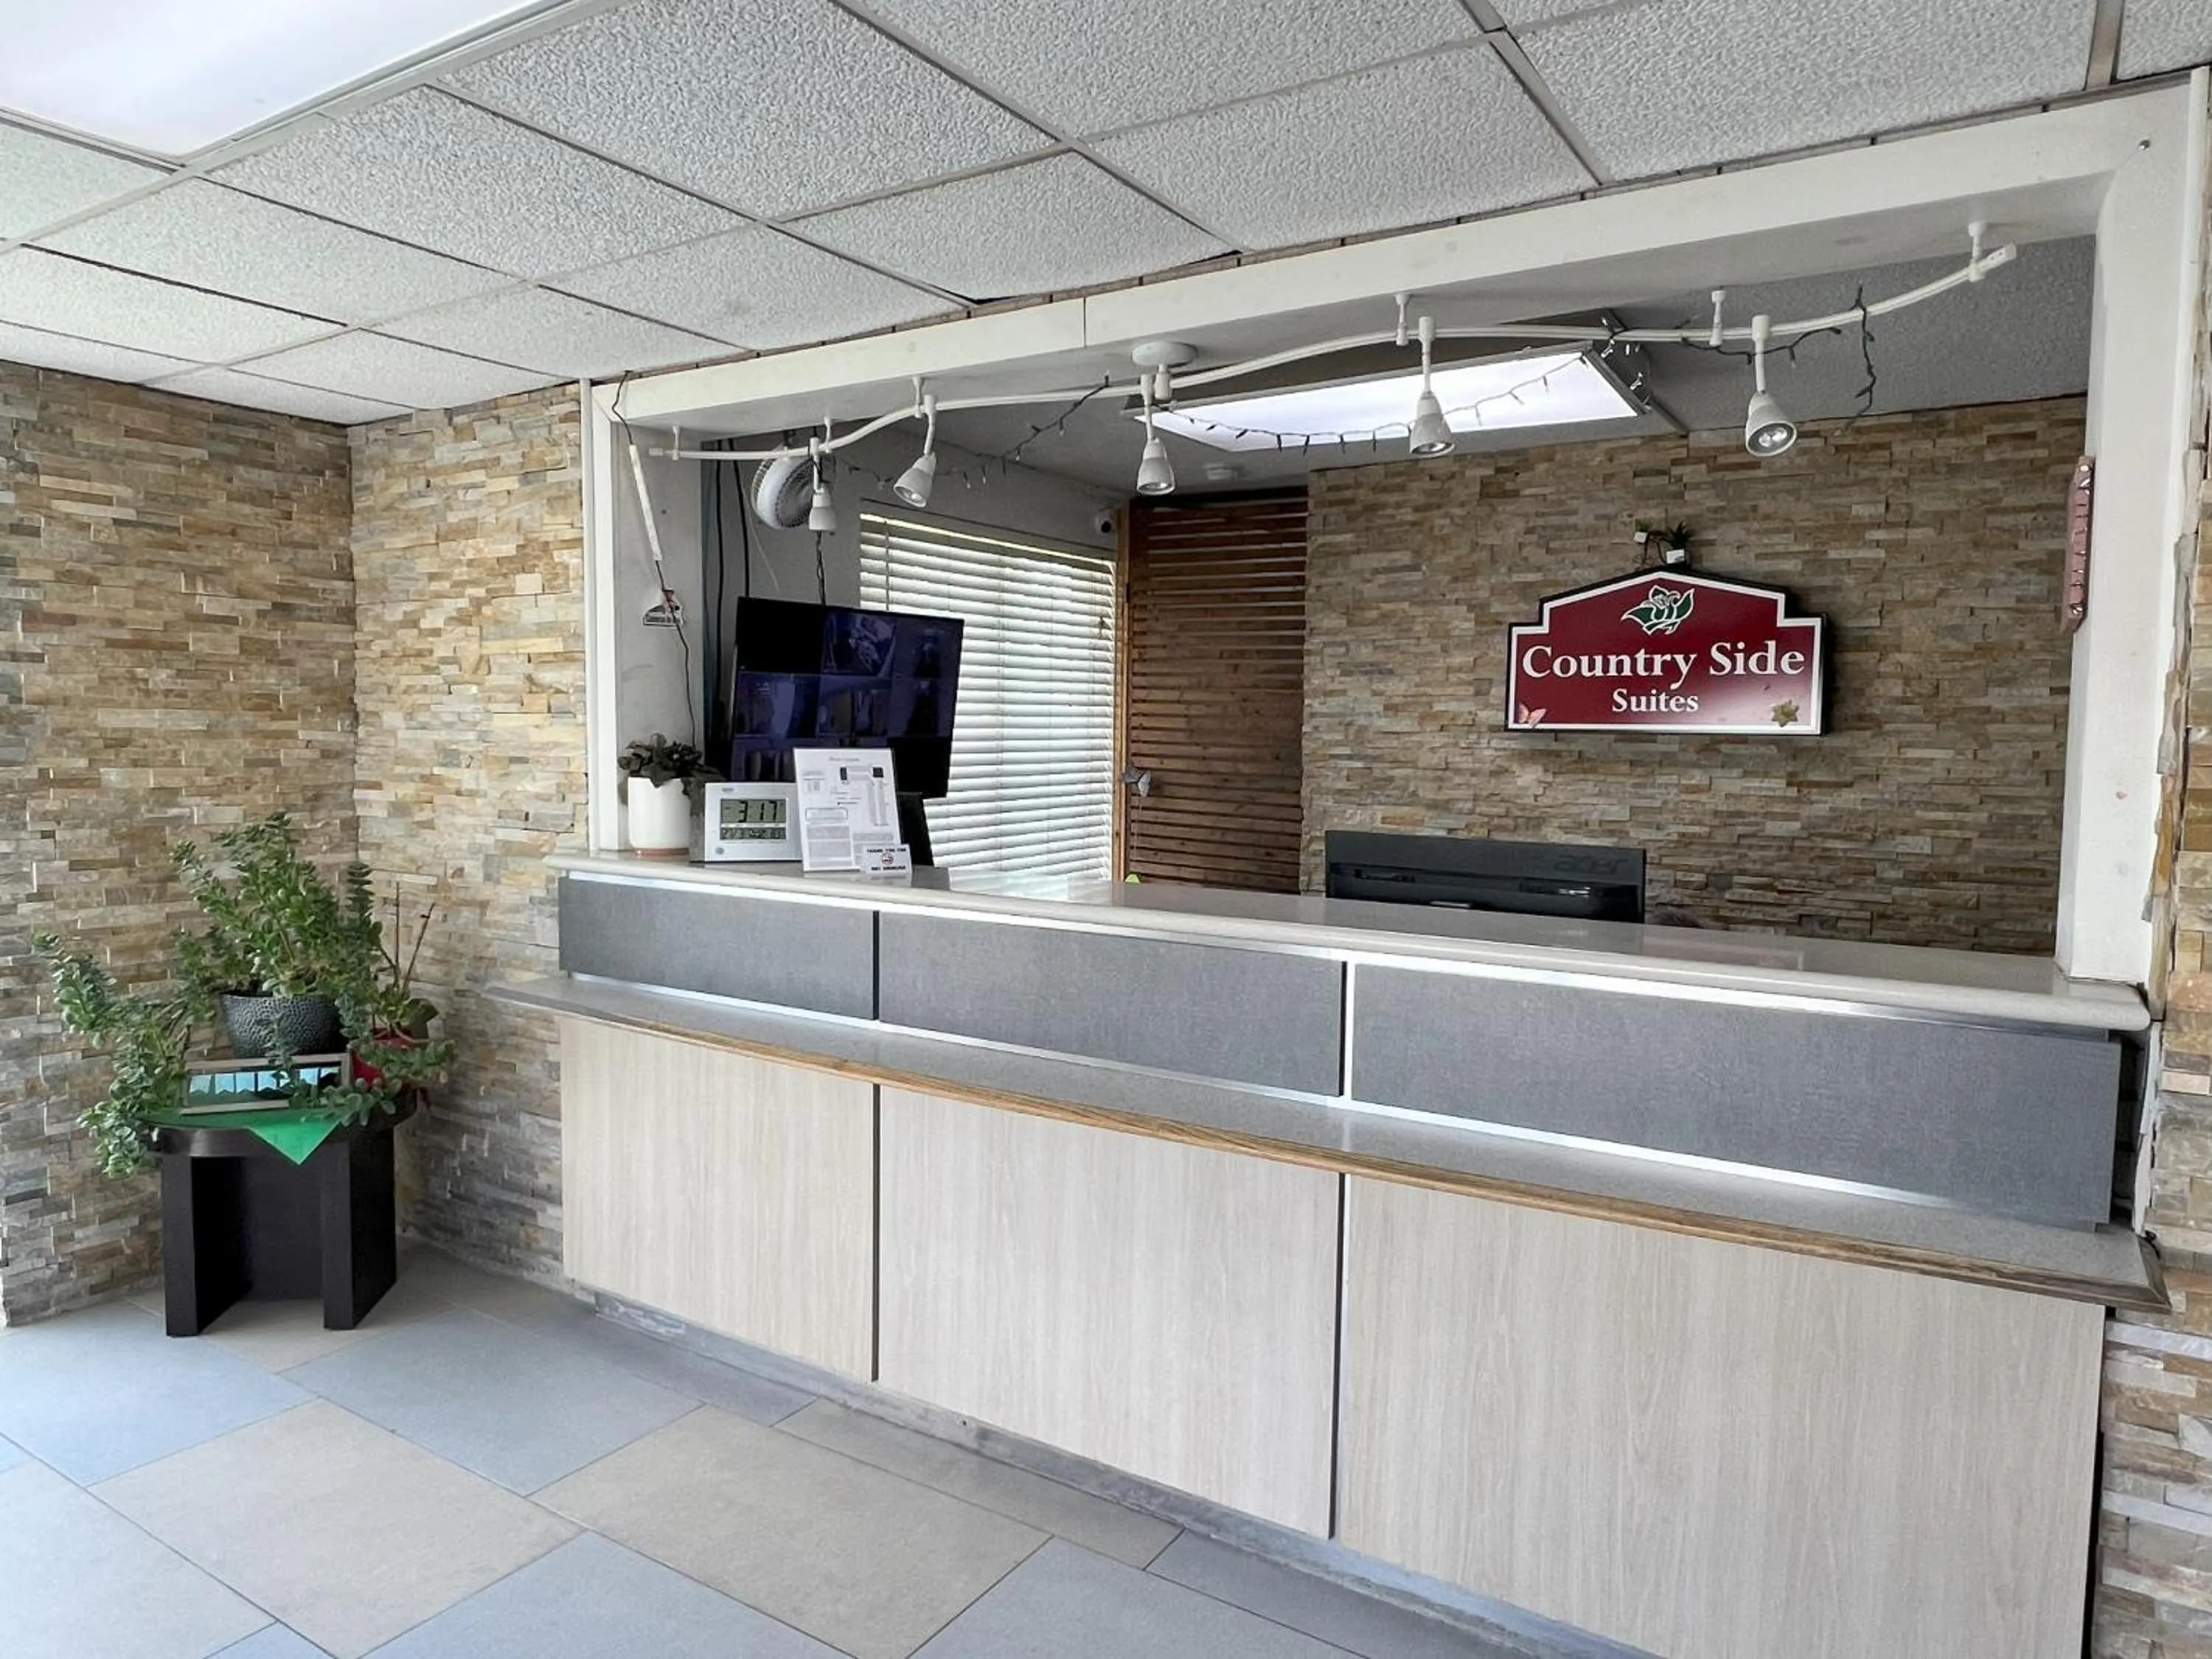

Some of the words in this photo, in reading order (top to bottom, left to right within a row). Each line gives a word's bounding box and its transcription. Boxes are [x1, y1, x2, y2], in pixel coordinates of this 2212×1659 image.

[1523, 646, 1697, 689] Country
[1710, 640, 1804, 675] Side
[1613, 689, 1699, 712] Suites
